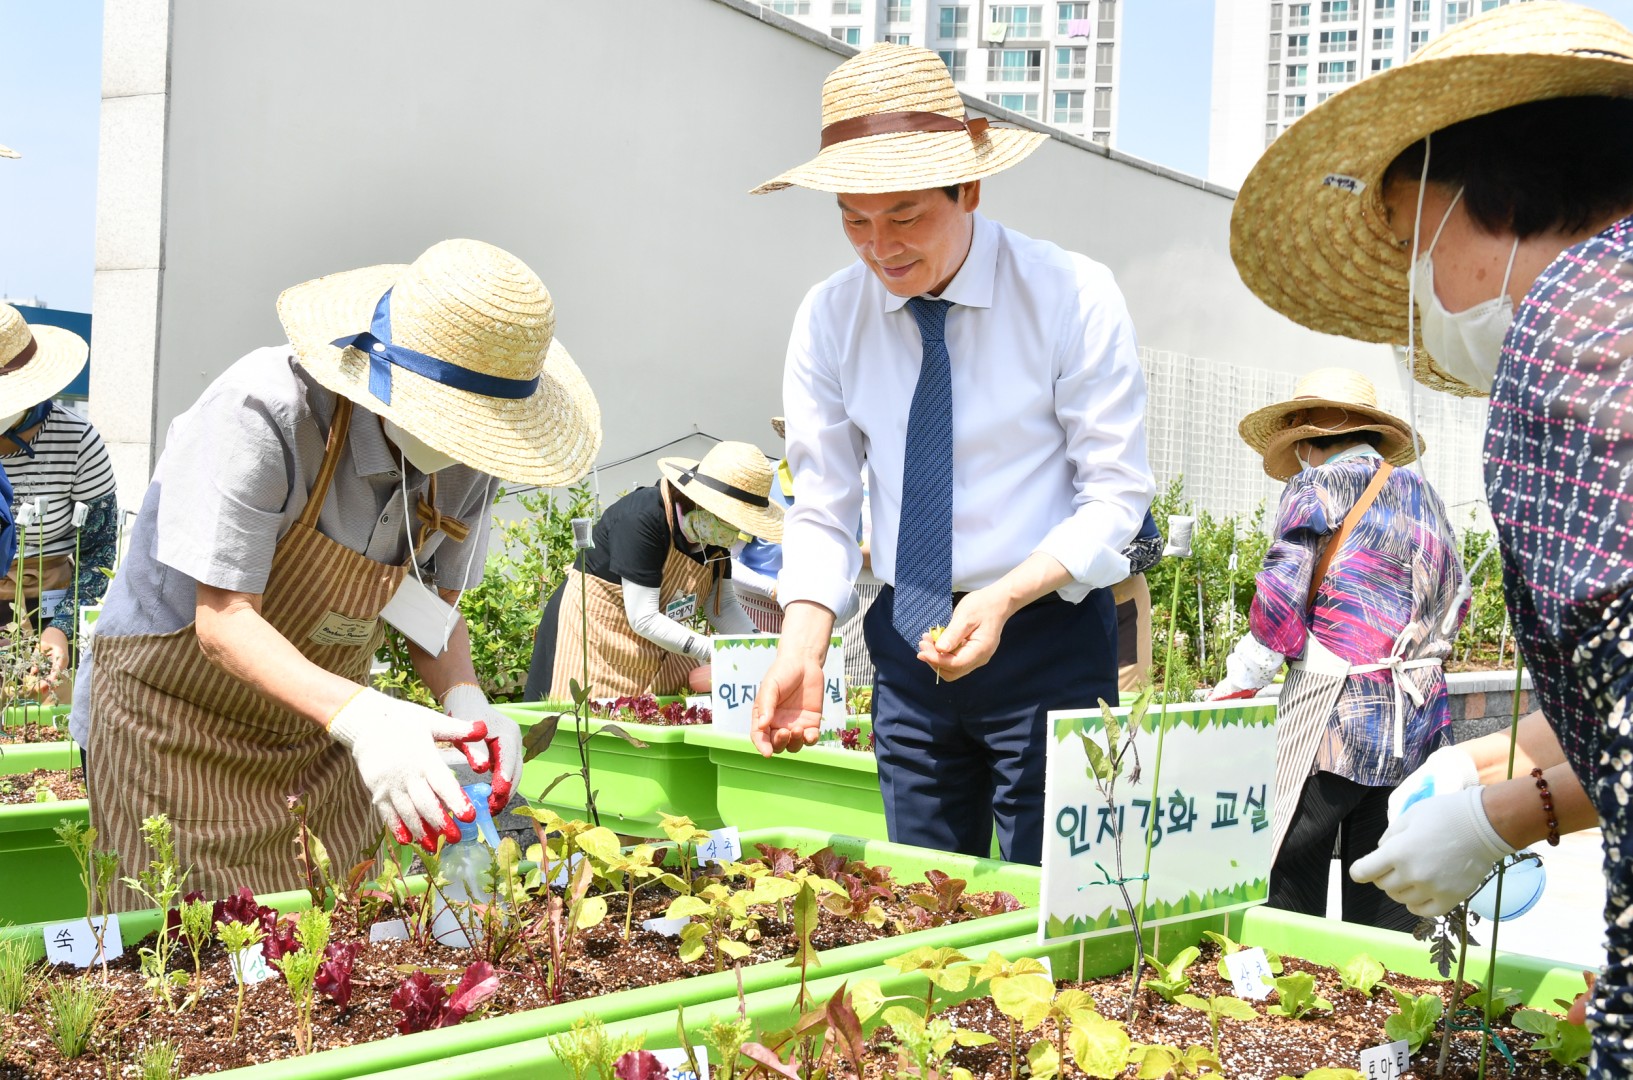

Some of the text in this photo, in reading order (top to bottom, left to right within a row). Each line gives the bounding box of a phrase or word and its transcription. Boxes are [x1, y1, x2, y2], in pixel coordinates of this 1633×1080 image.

[719, 678, 842, 709] 인지 실
[1055, 784, 1269, 857] 인지강화 교실
